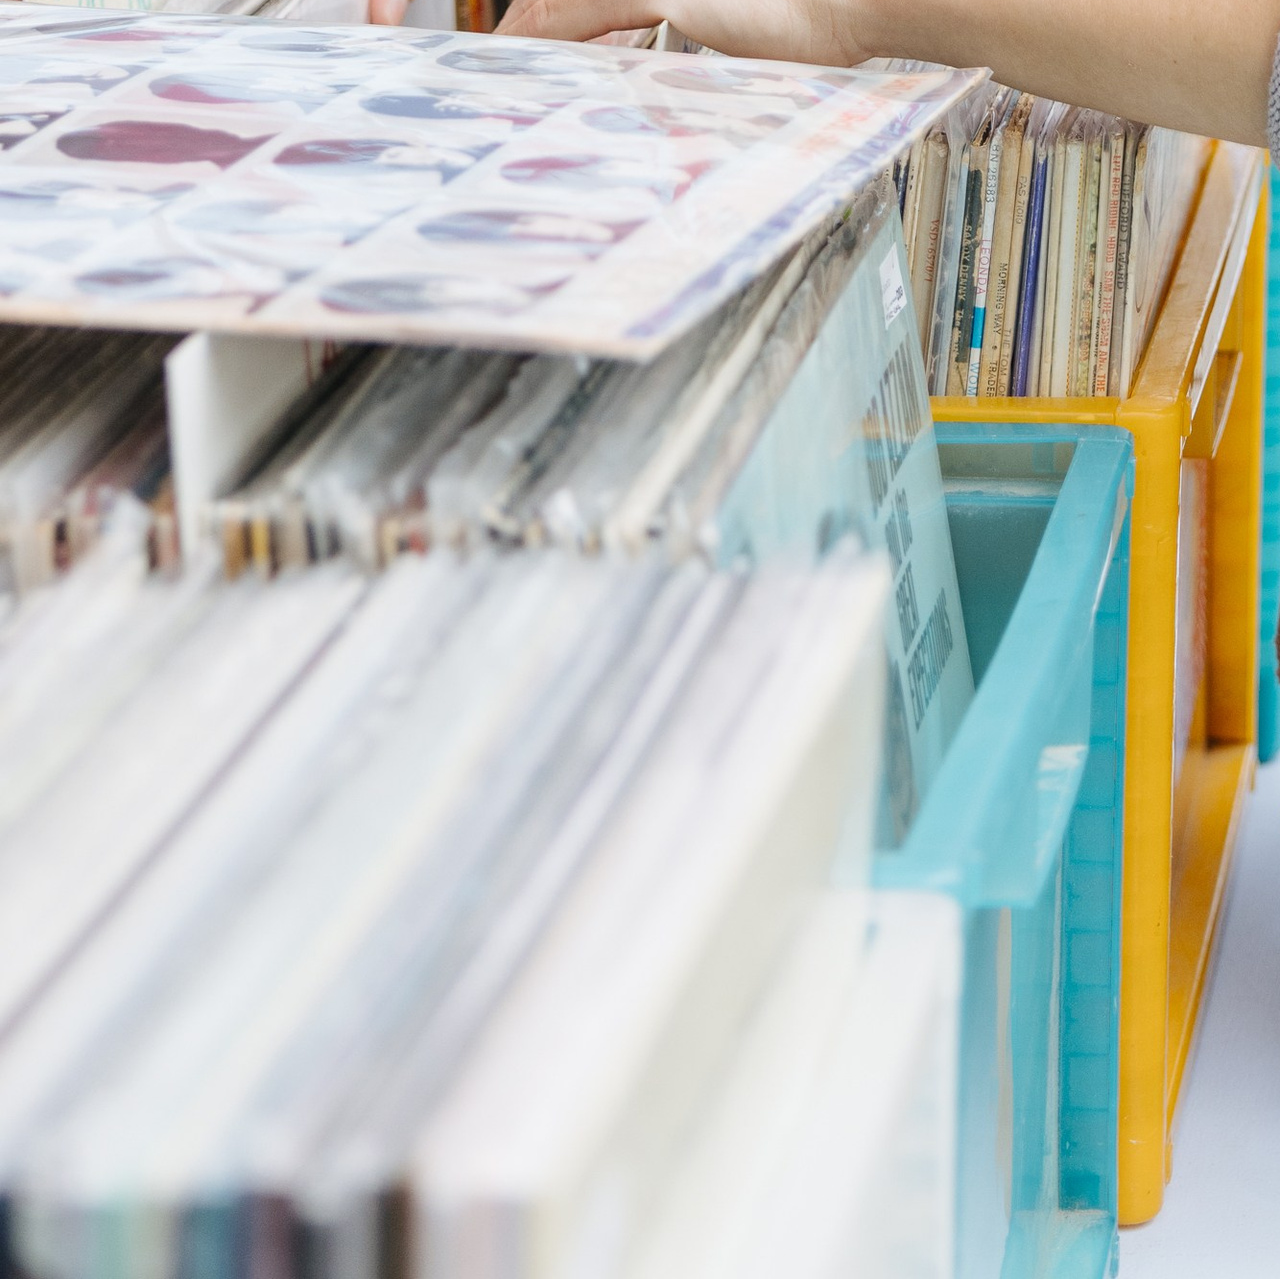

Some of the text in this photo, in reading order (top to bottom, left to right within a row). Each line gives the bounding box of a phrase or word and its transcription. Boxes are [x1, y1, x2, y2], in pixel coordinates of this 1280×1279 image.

[1018, 175, 1027, 197] PAS
[1120, 174, 1131, 233] CLIFFORD
[967, 144, 1000, 396] BN 26383 LEONDA WOM
[1103, 270, 1114, 293] SAM
[1116, 252, 1126, 290] WARD
[958, 264, 970, 302] DENNY
[996, 262, 1008, 309] MORNING
[1101, 295, 1111, 314] THE
[992, 313, 1003, 335] WAY
[1003, 328, 1012, 349] THE
[1000, 353, 1010, 376] TOM
[998, 378, 1008, 397] JON
[1096, 373, 1106, 392] THE
[895, 559, 921, 659] GREAT
[907, 587, 954, 734] EXPECTATIONS
